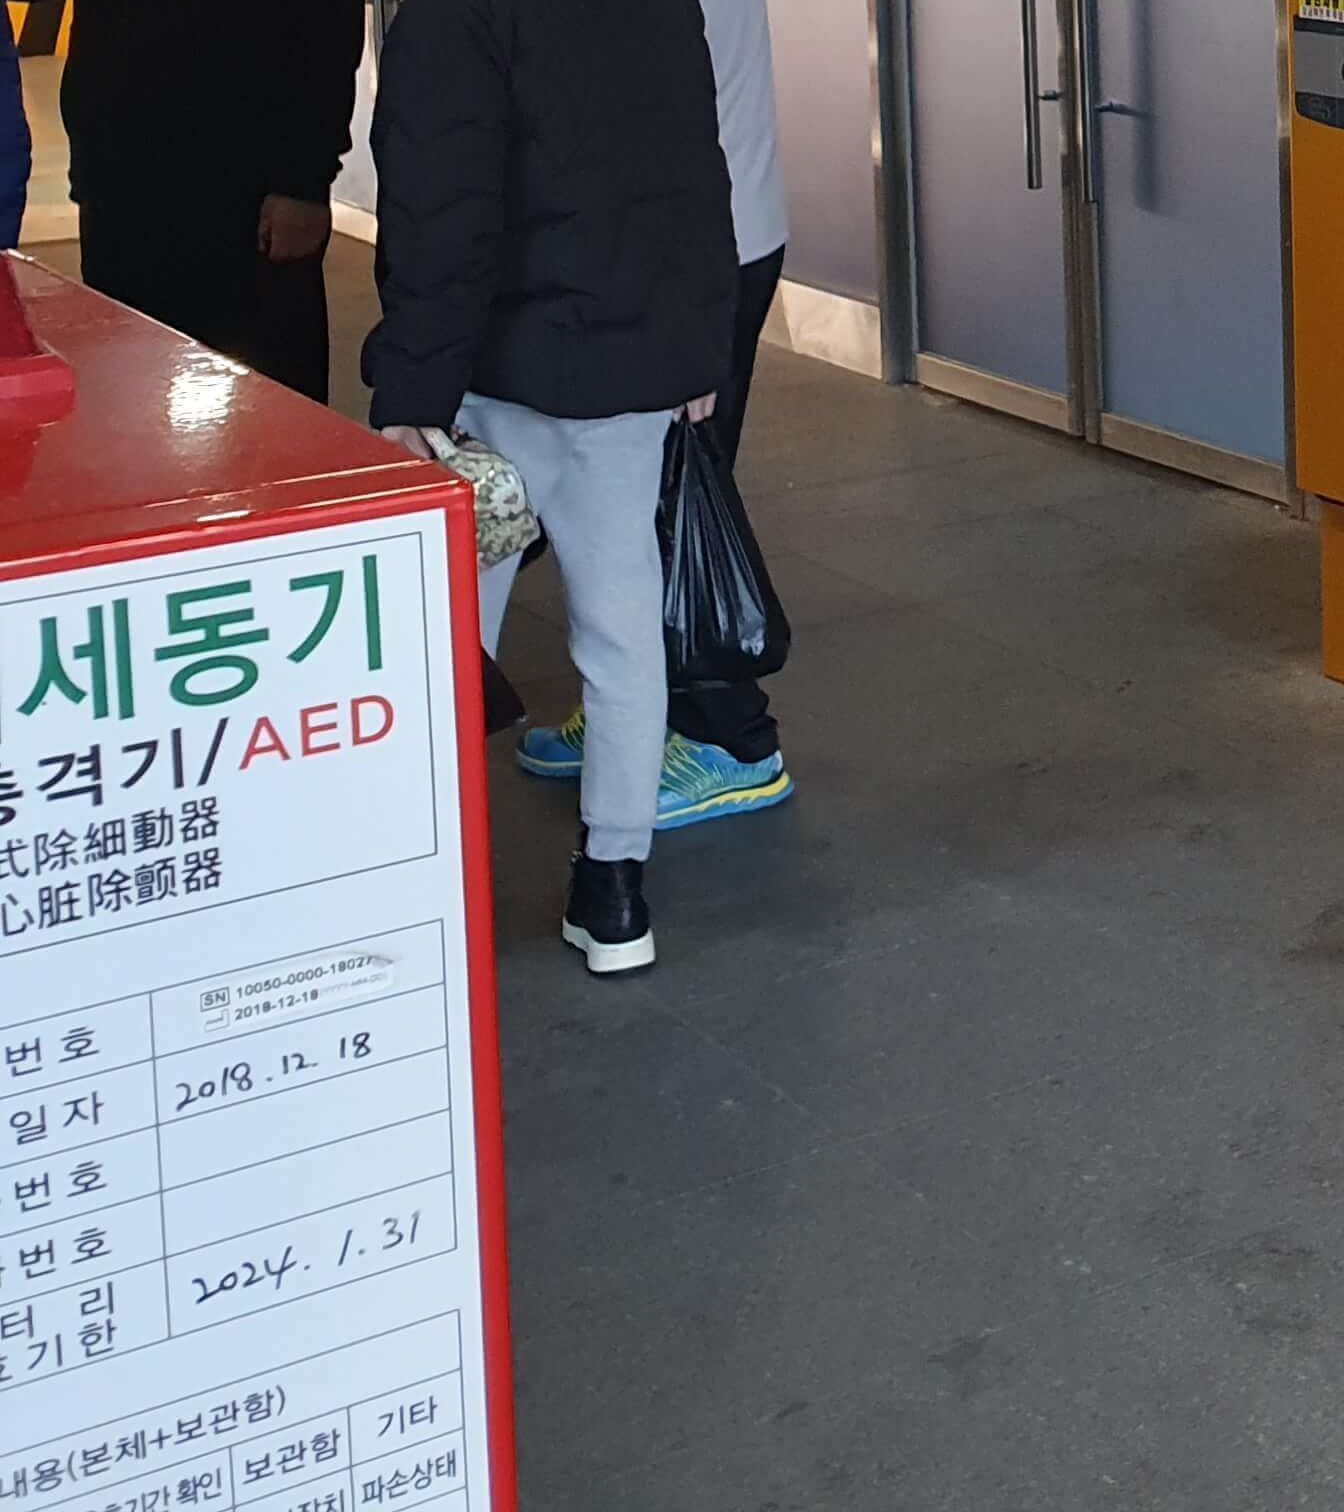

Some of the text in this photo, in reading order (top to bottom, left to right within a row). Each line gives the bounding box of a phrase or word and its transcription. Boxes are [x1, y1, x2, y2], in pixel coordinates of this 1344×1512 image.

[16, 553, 384, 721] 세동기
[203, 990, 228, 1008] SN
[0, 1226, 113, 1280] 번호
[377, 1394, 439, 1438] 기타
[241, 1427, 342, 1486] 보관함
[360, 1448, 458, 1505] 파손상태
